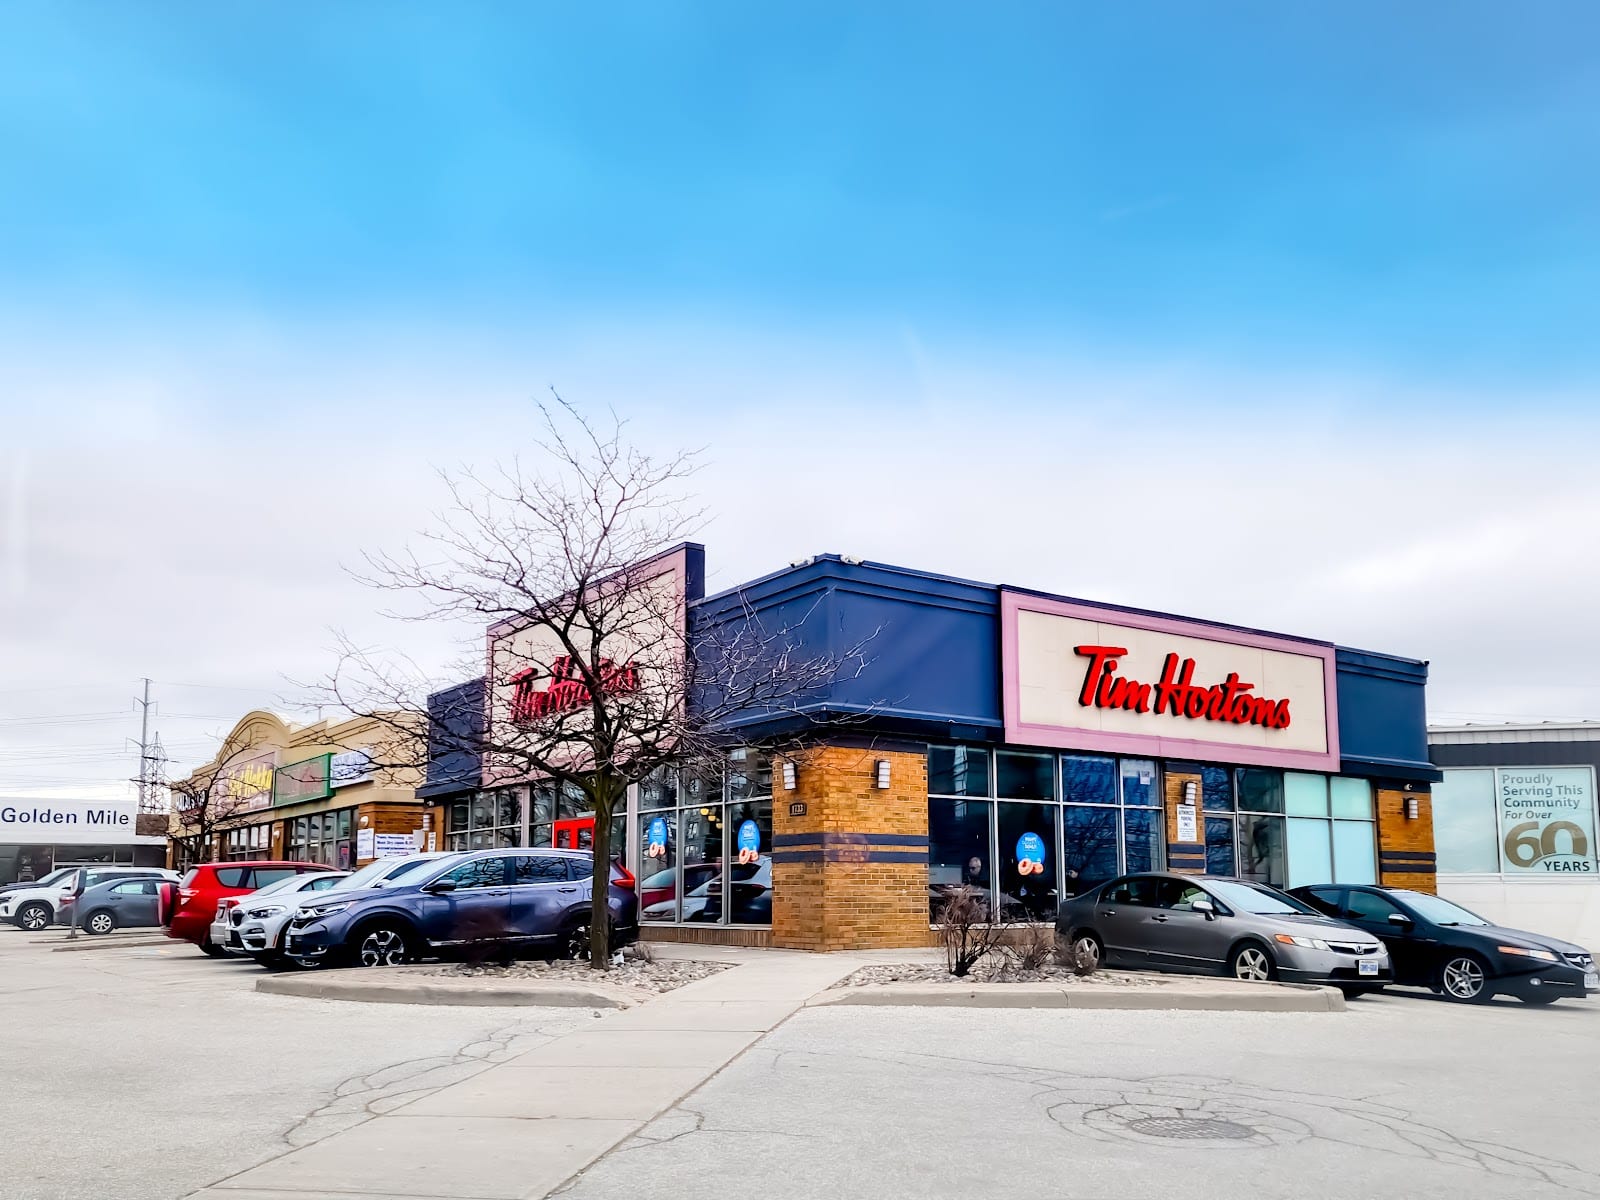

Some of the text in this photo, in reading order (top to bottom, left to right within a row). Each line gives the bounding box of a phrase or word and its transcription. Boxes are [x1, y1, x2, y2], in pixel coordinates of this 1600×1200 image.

[1073, 645, 1291, 729] Tim Hortons
[1502, 774, 1553, 786] Proudly
[1503, 785, 1583, 798] Serving This
[1504, 797, 1580, 810] Community
[1, 807, 129, 825] Golden Mile
[1505, 810, 1552, 819] For Over
[1504, 821, 1587, 868] 60
[1544, 861, 1590, 871] YEARS
